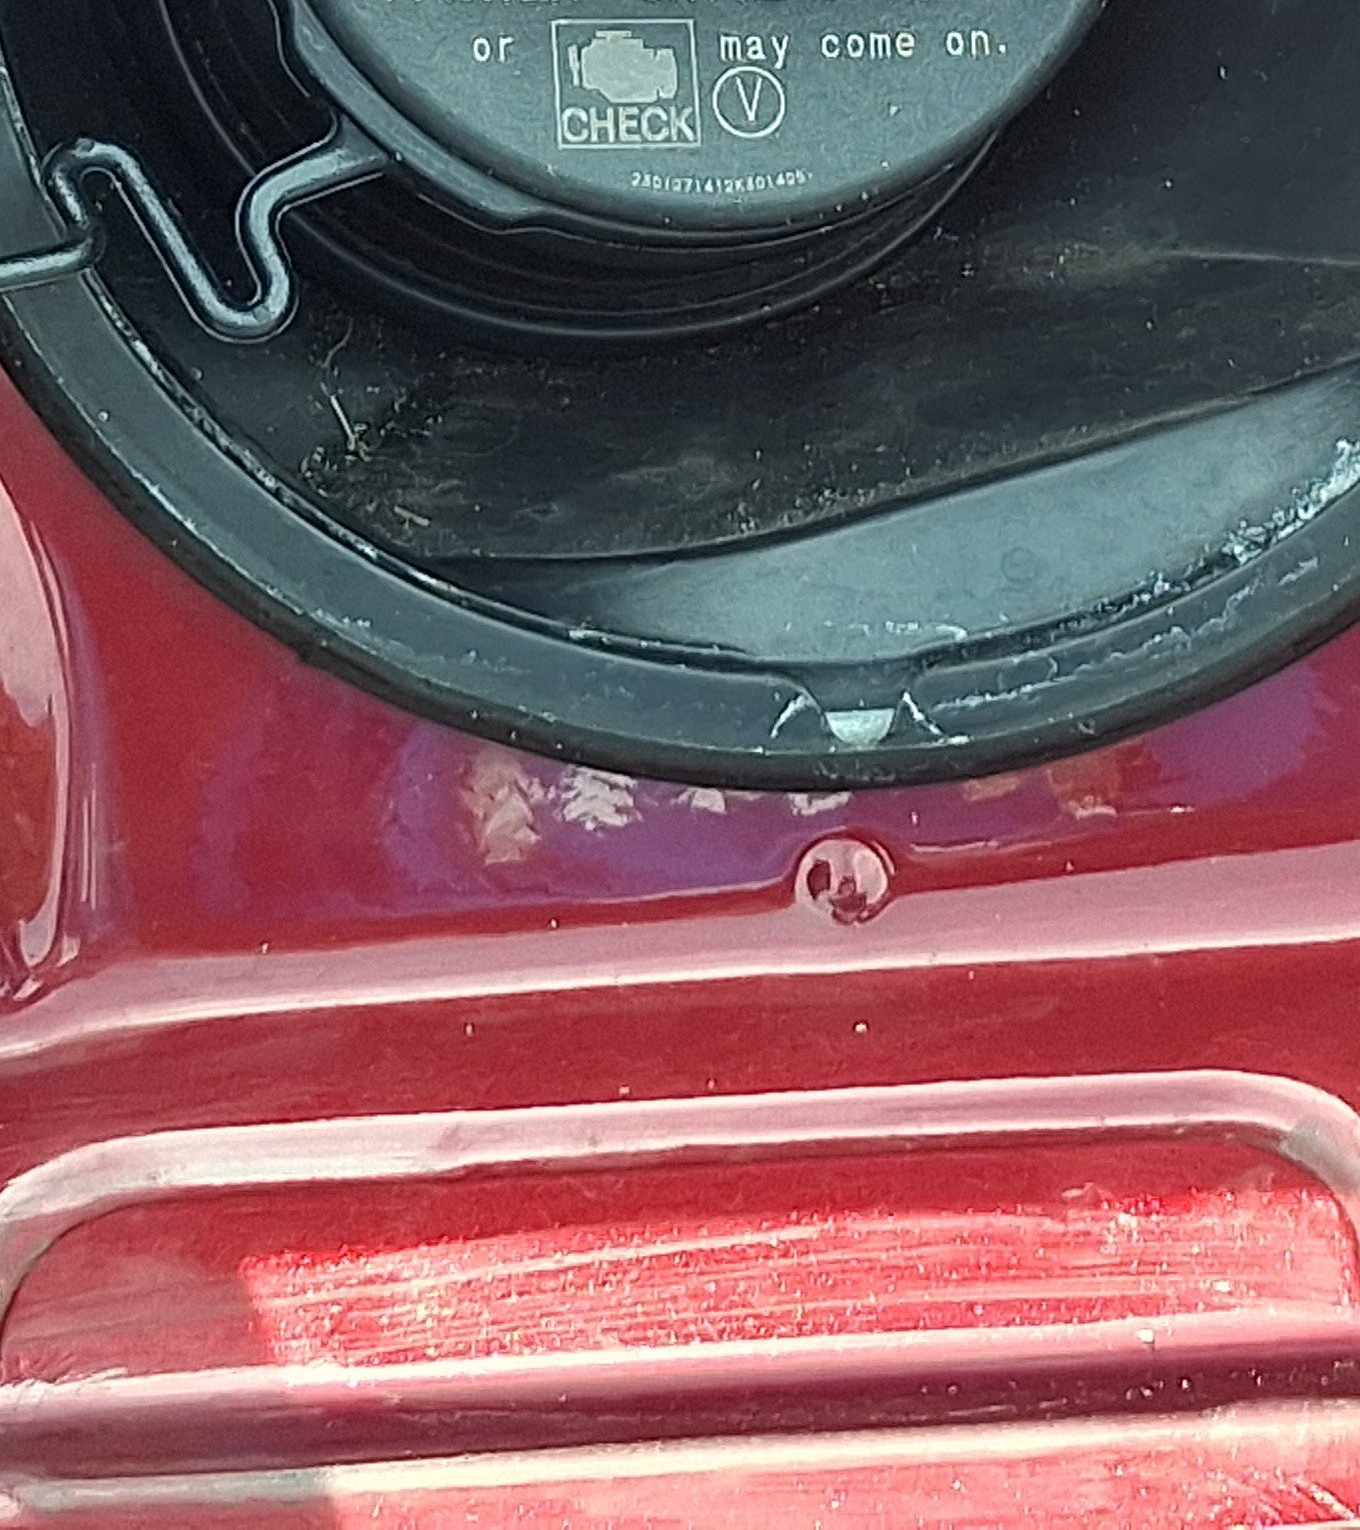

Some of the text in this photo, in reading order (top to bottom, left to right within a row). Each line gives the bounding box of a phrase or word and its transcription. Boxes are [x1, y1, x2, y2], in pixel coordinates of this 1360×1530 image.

[473, 25, 1008, 69] or may come on.
[560, 105, 696, 143] CHECK
